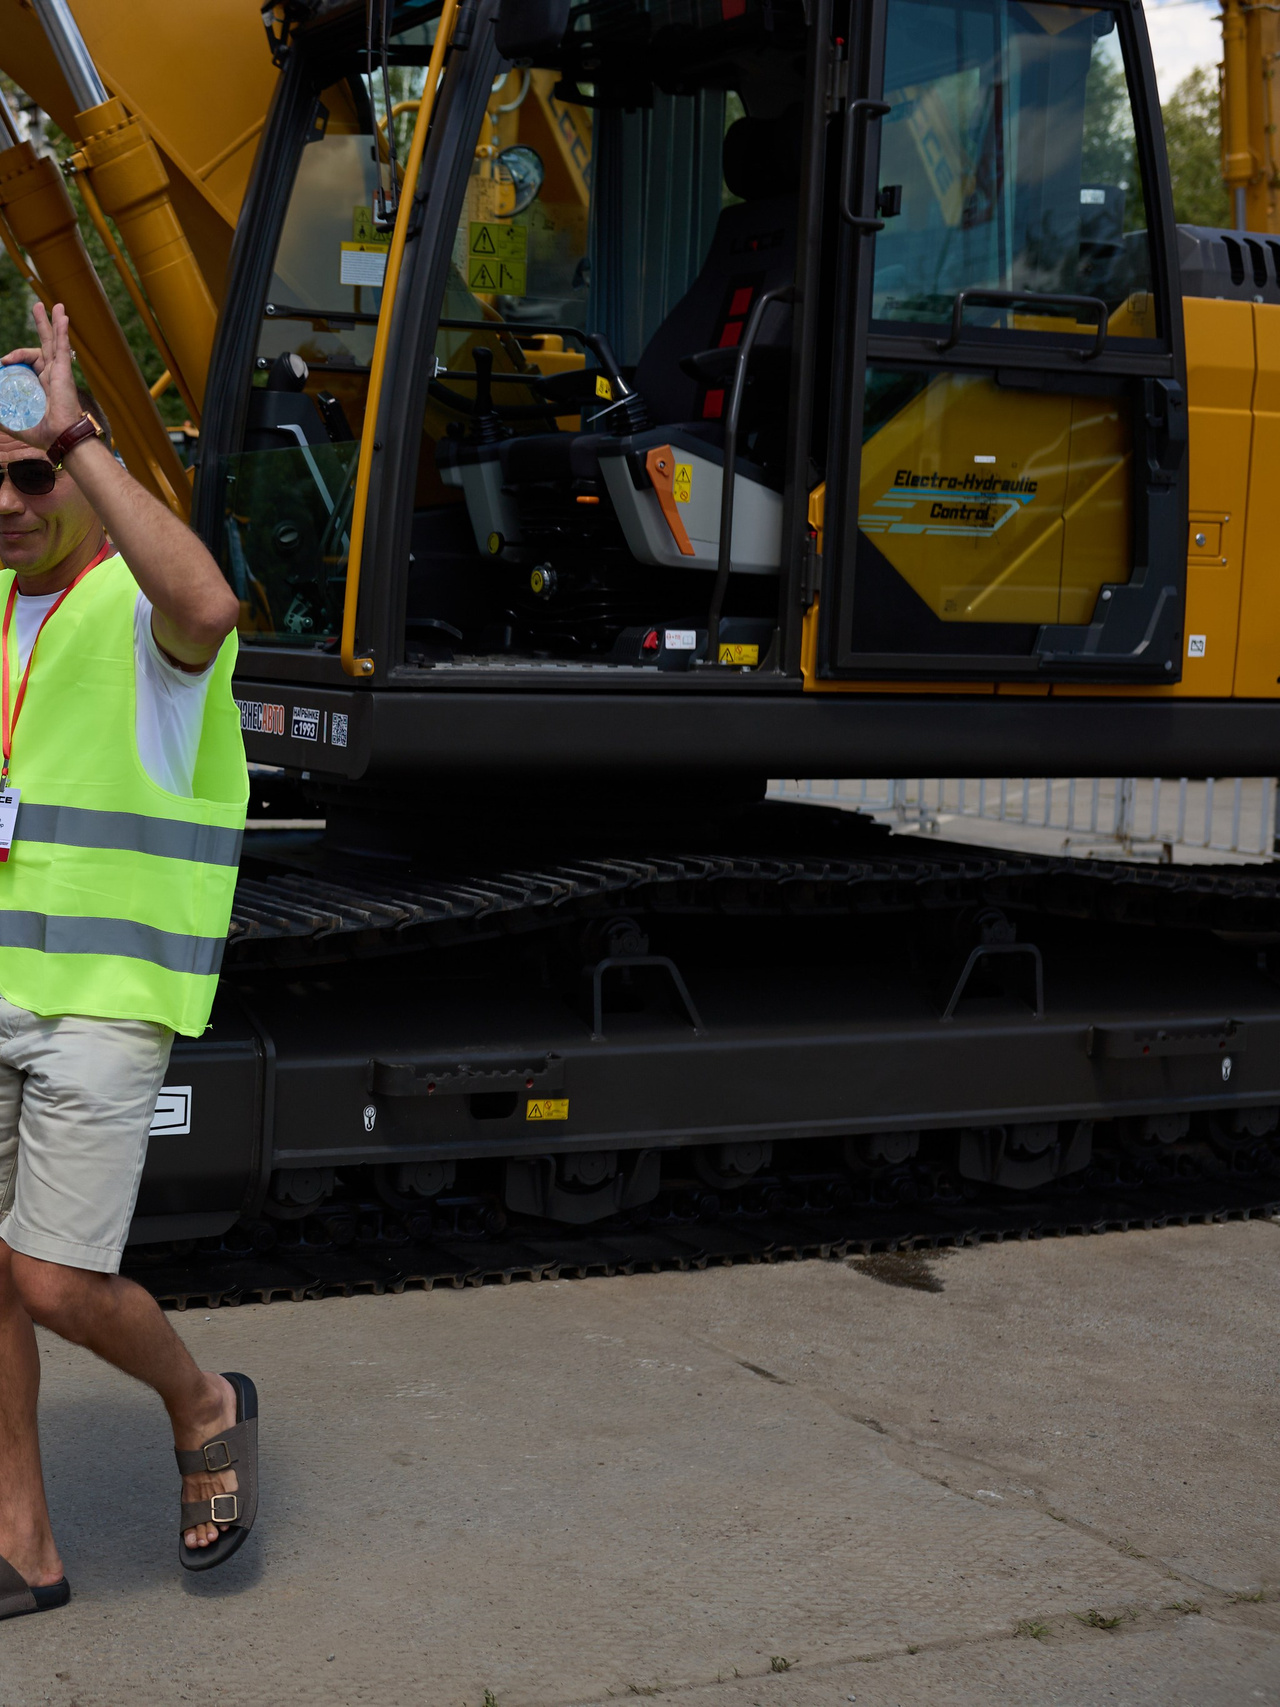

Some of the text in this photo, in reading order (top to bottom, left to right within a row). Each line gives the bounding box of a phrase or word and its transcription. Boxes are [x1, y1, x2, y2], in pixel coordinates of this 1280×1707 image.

[894, 470, 1038, 493] Electro-Hydraulic
[930, 503, 990, 521] Control
[235, 700, 284, 734] ЗНЕСАВТО
[299, 721, 315, 737] 1993
